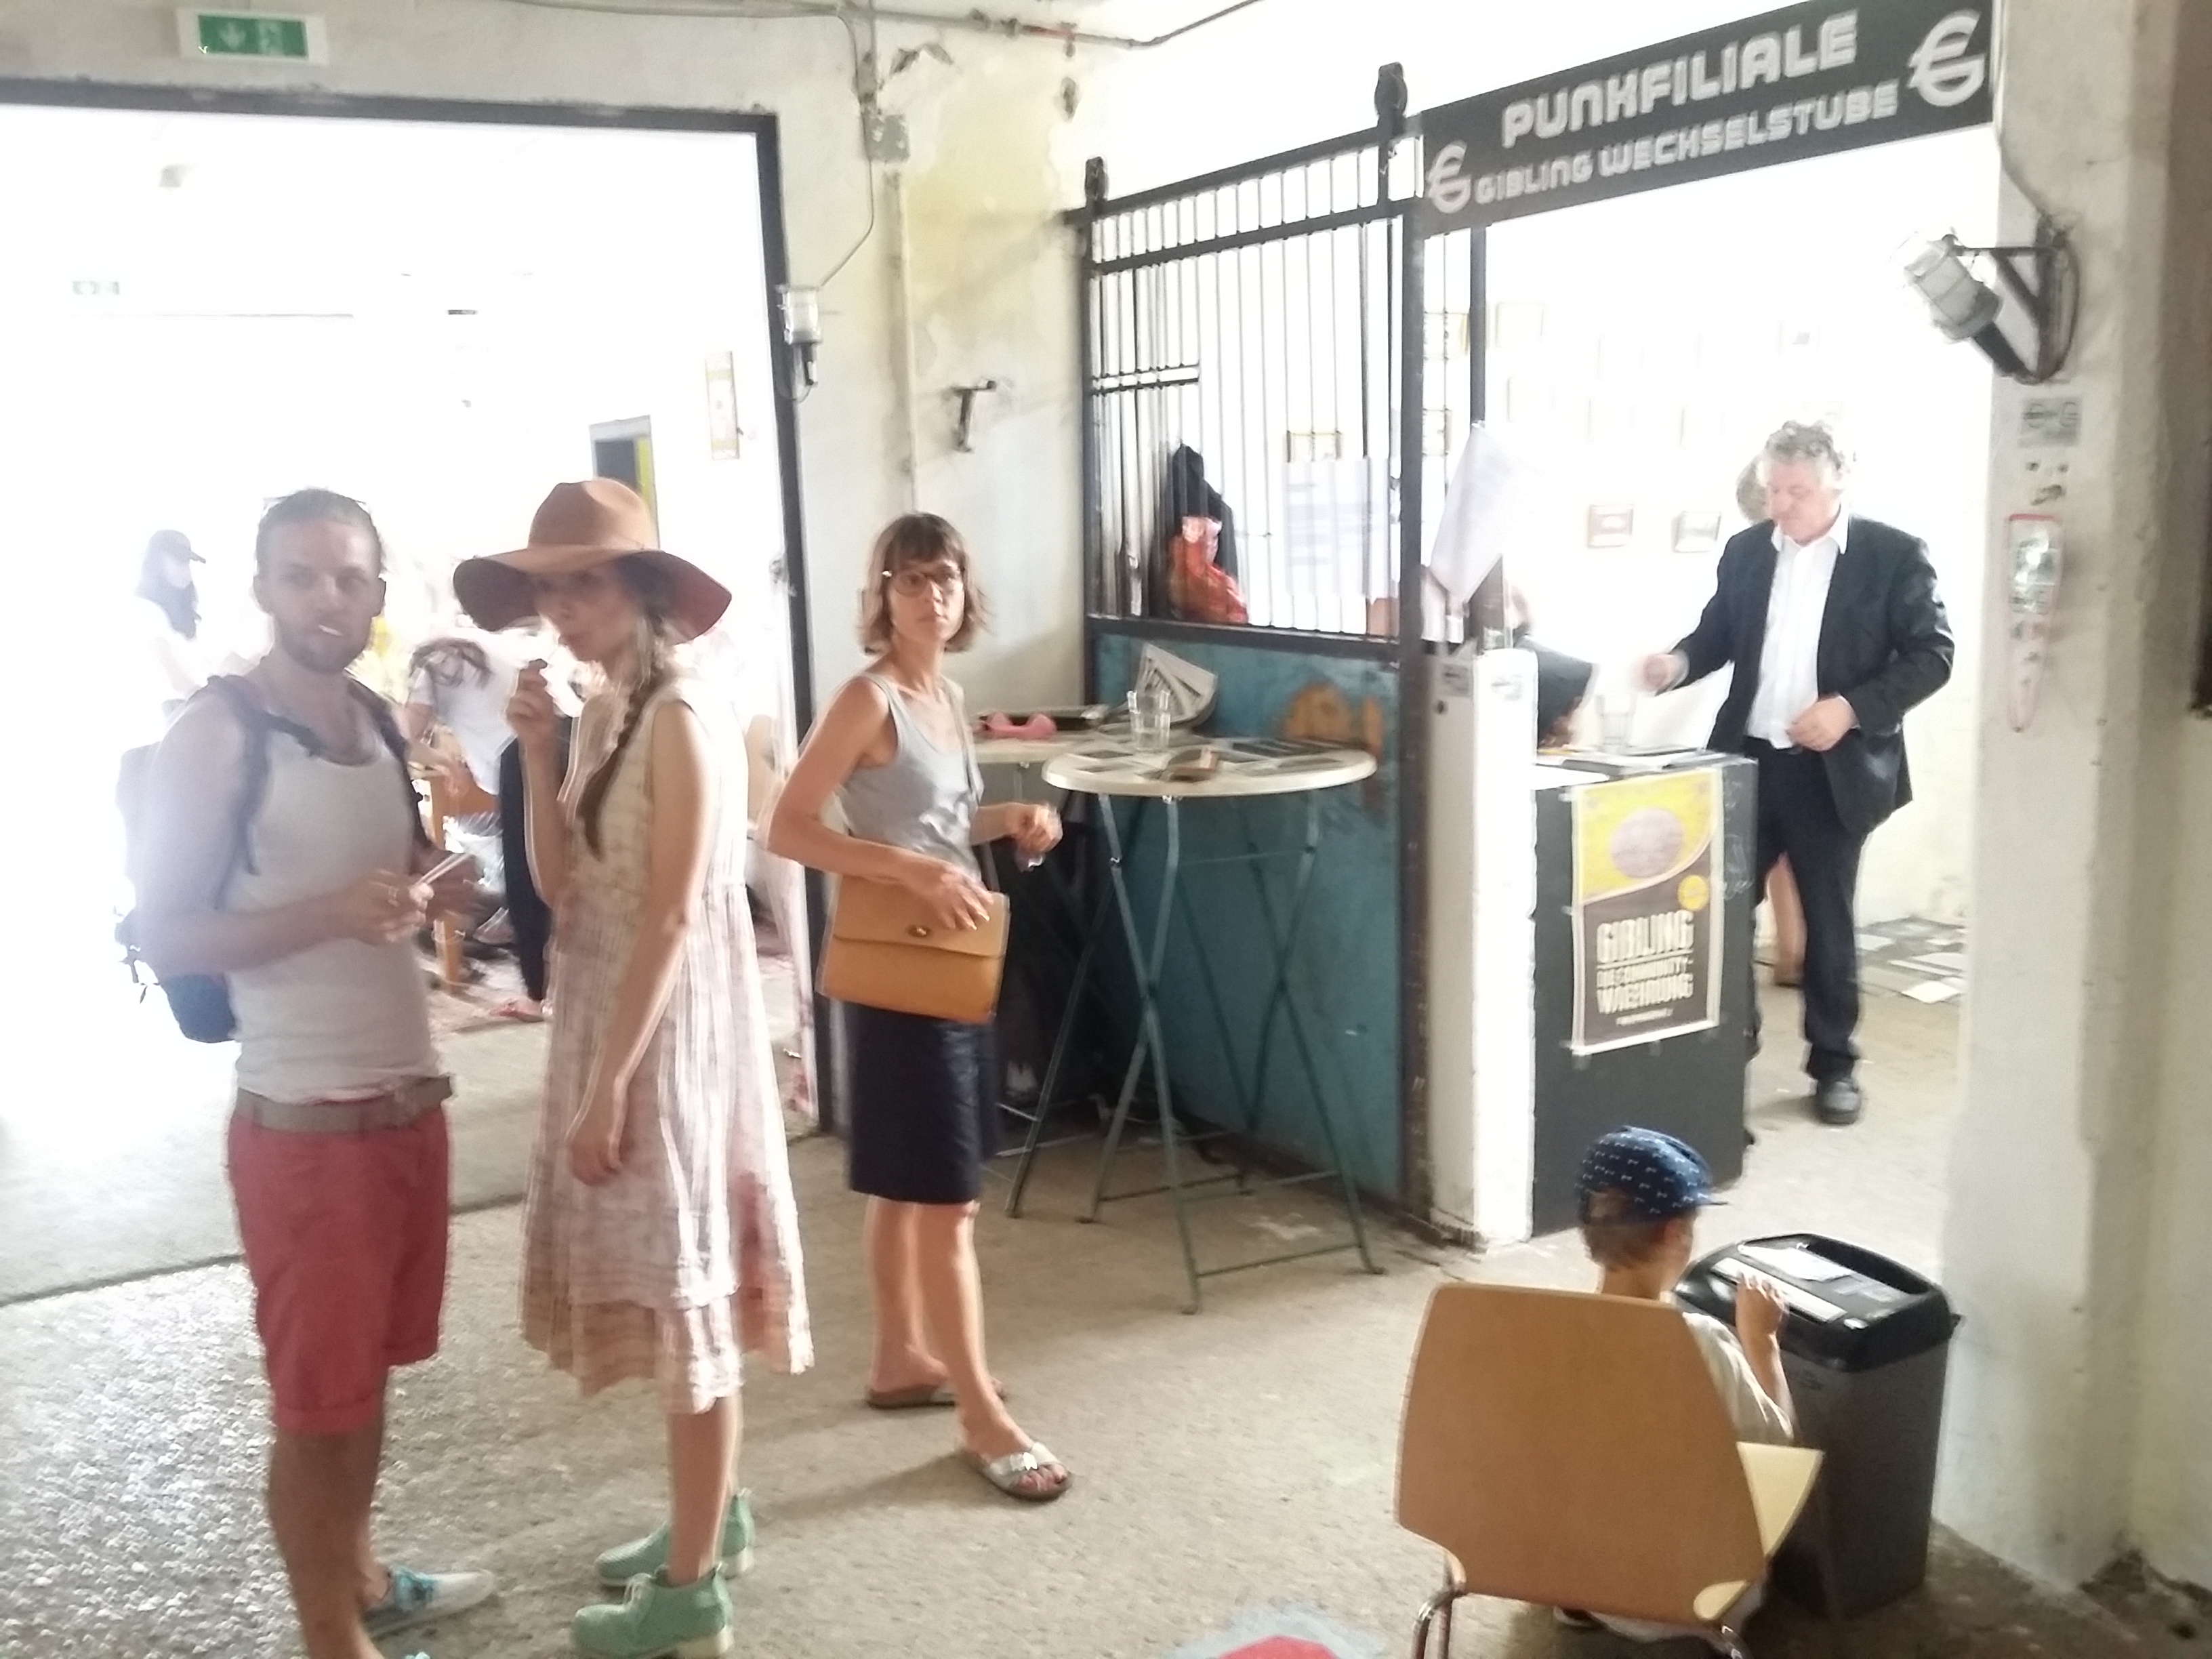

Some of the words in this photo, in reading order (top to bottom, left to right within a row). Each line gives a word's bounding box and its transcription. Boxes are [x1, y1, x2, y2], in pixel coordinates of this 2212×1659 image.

[1474, 150, 1593, 205] GIBLING
[1598, 79, 1898, 178] WECHSELSTUBE
[1502, 9, 1858, 148] PUNKFILIALE
